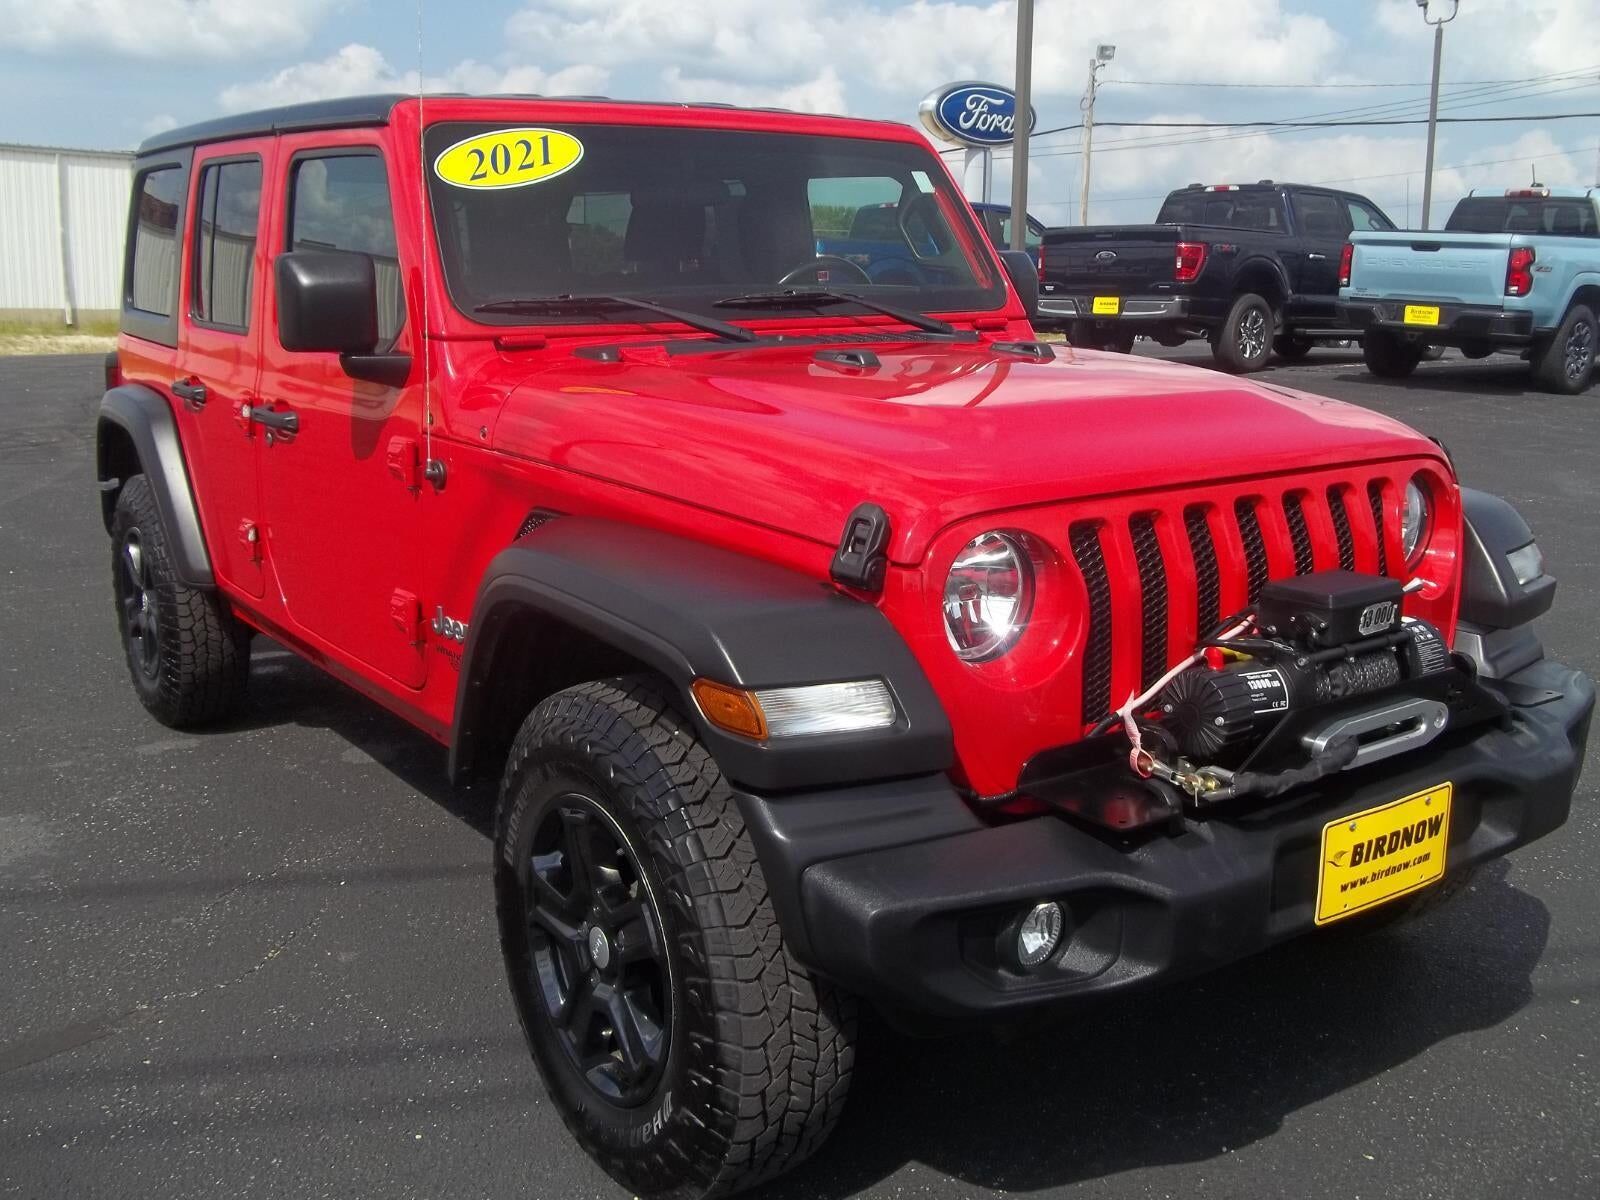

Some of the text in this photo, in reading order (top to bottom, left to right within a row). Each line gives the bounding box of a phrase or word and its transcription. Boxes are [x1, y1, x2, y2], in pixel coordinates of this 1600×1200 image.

[466, 134, 553, 181] 2021
[1247, 679, 1271, 690] 13000
[1349, 813, 1445, 868] BIRDNOW
[1340, 852, 1431, 893] www.birdnow.com
